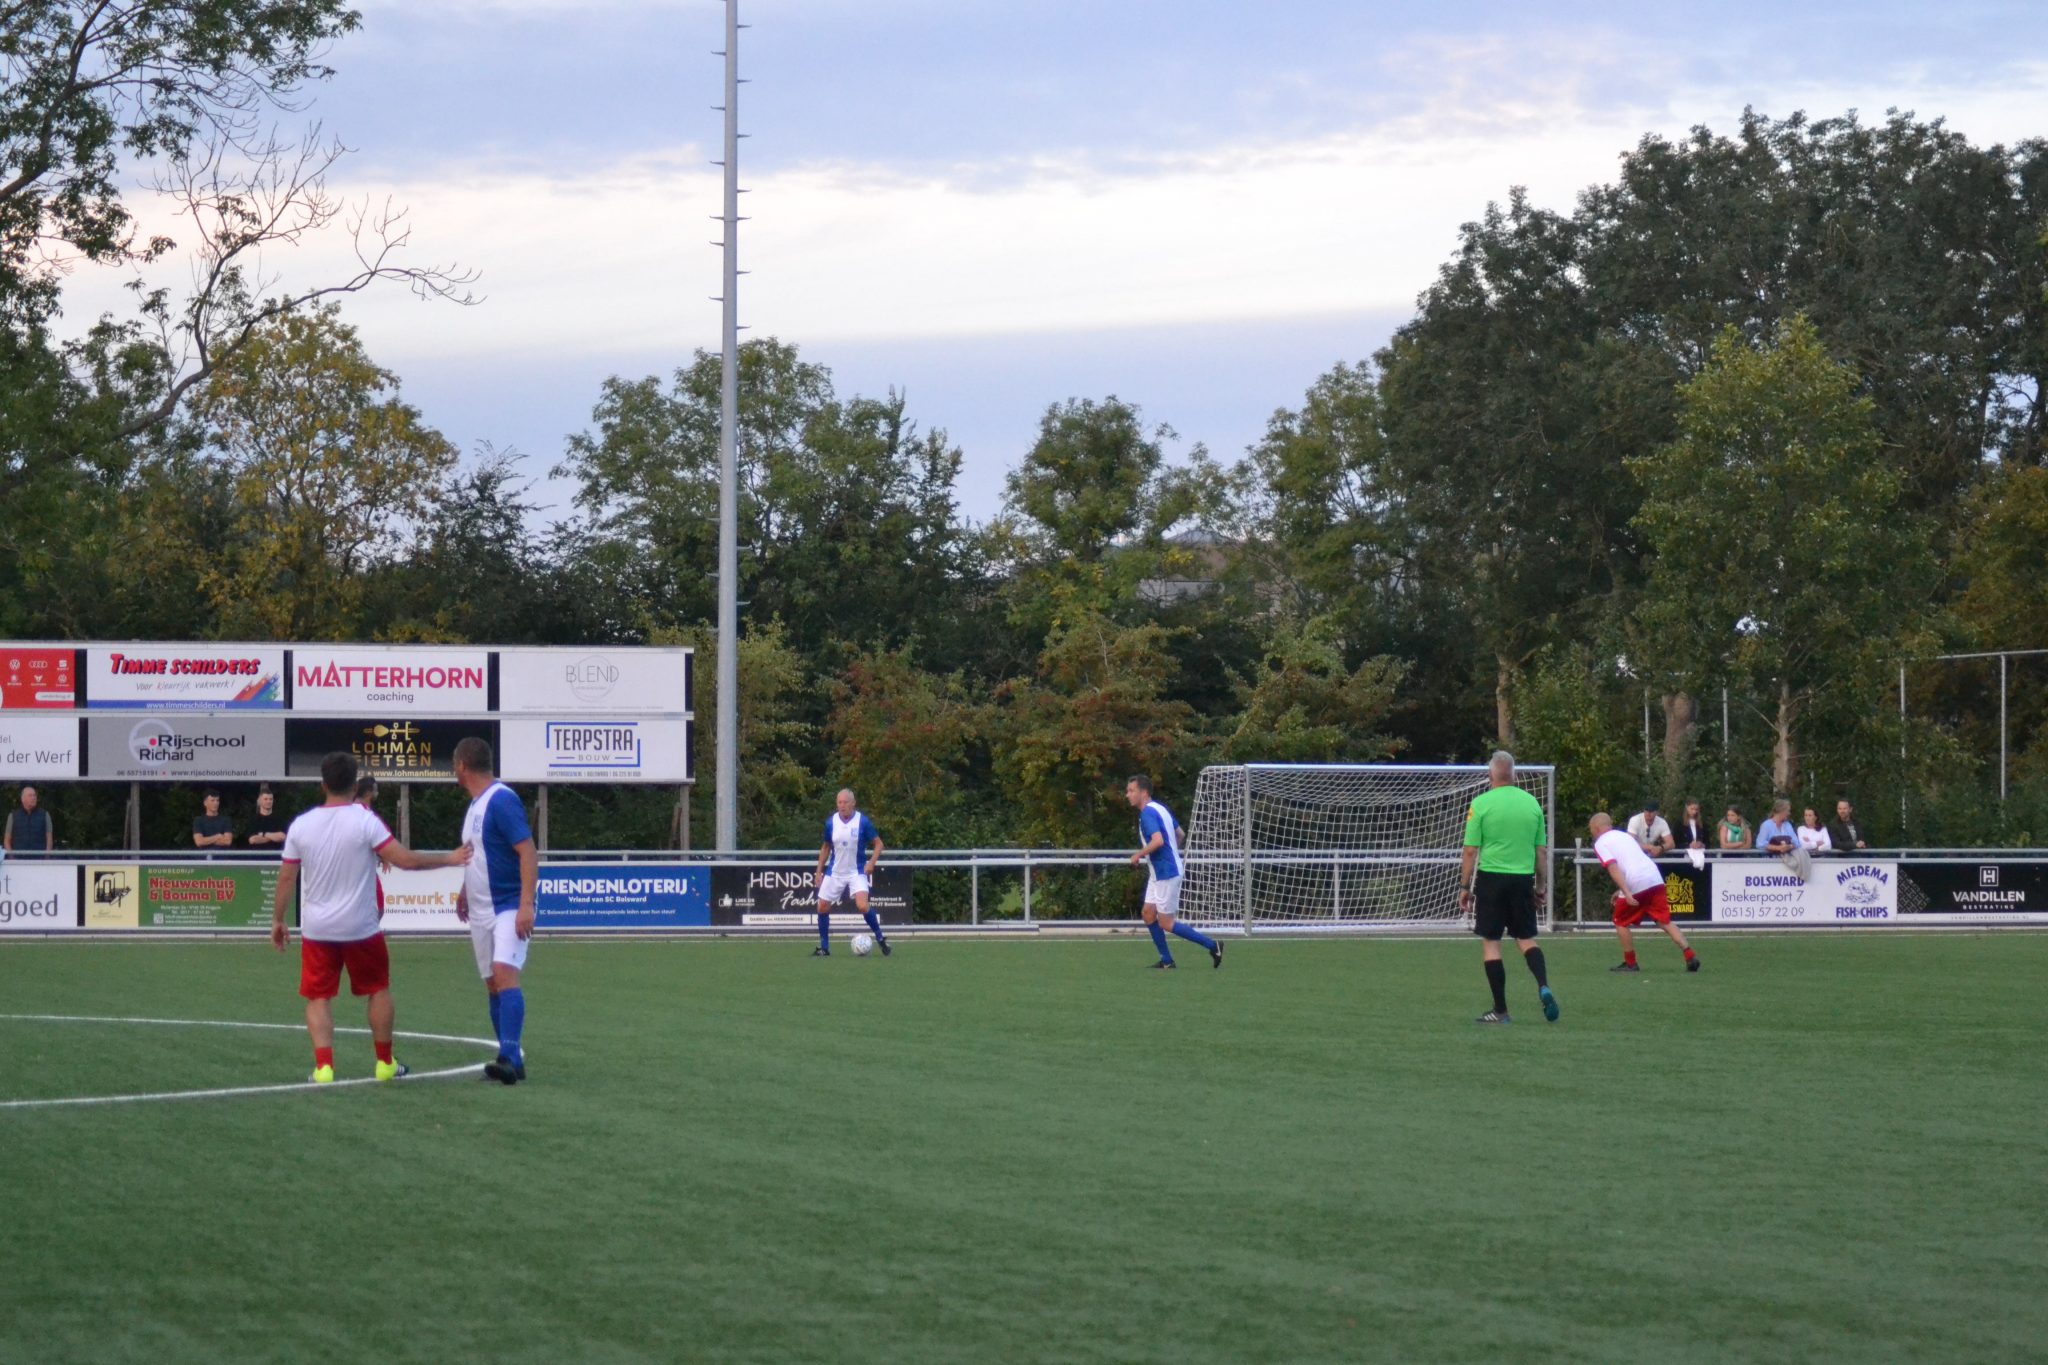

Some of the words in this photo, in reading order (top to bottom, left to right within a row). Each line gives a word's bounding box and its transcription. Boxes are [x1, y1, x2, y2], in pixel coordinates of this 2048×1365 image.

[110, 654, 167, 675] TIMME
[170, 659, 261, 675] SCHILDERS
[298, 659, 482, 688] MATTERHORN
[565, 665, 620, 683] BLEND
[366, 691, 414, 703] coaching
[146, 701, 226, 709] www.timmeschilders.nl
[158, 735, 245, 749] Rijschool
[554, 729, 633, 751] TERPSTRA
[352, 741, 432, 754] LOHMAN
[7, 750, 30, 763] der
[35, 750, 72, 764] Werf
[139, 749, 194, 761] Richard
[578, 754, 611, 762] BOUW
[171, 769, 257, 777] www.rijschoolrichard.nl
[1836, 865, 1889, 885] MIEDEMA
[149, 877, 235, 889] Nieuwenhuis
[1745, 876, 1805, 887] BOLSWARD
[149, 890, 158, 901] &
[163, 890, 210, 901] Bouma
[216, 890, 235, 901] BV
[569, 895, 590, 903] Vriend
[616, 895, 647, 903] Bolsward
[1721, 889, 1792, 905] Snekerpoort
[1796, 890, 1804, 902] 7
[1953, 891, 2025, 902] VANDILLEN
[1721, 906, 1755, 919] (0515)
[1758, 906, 1771, 918] 57
[1775, 906, 1788, 918] 22
[1791, 906, 1805, 918] 09
[1836, 907, 1856, 918] FISH
[1860, 907, 1888, 918] CHIPS
